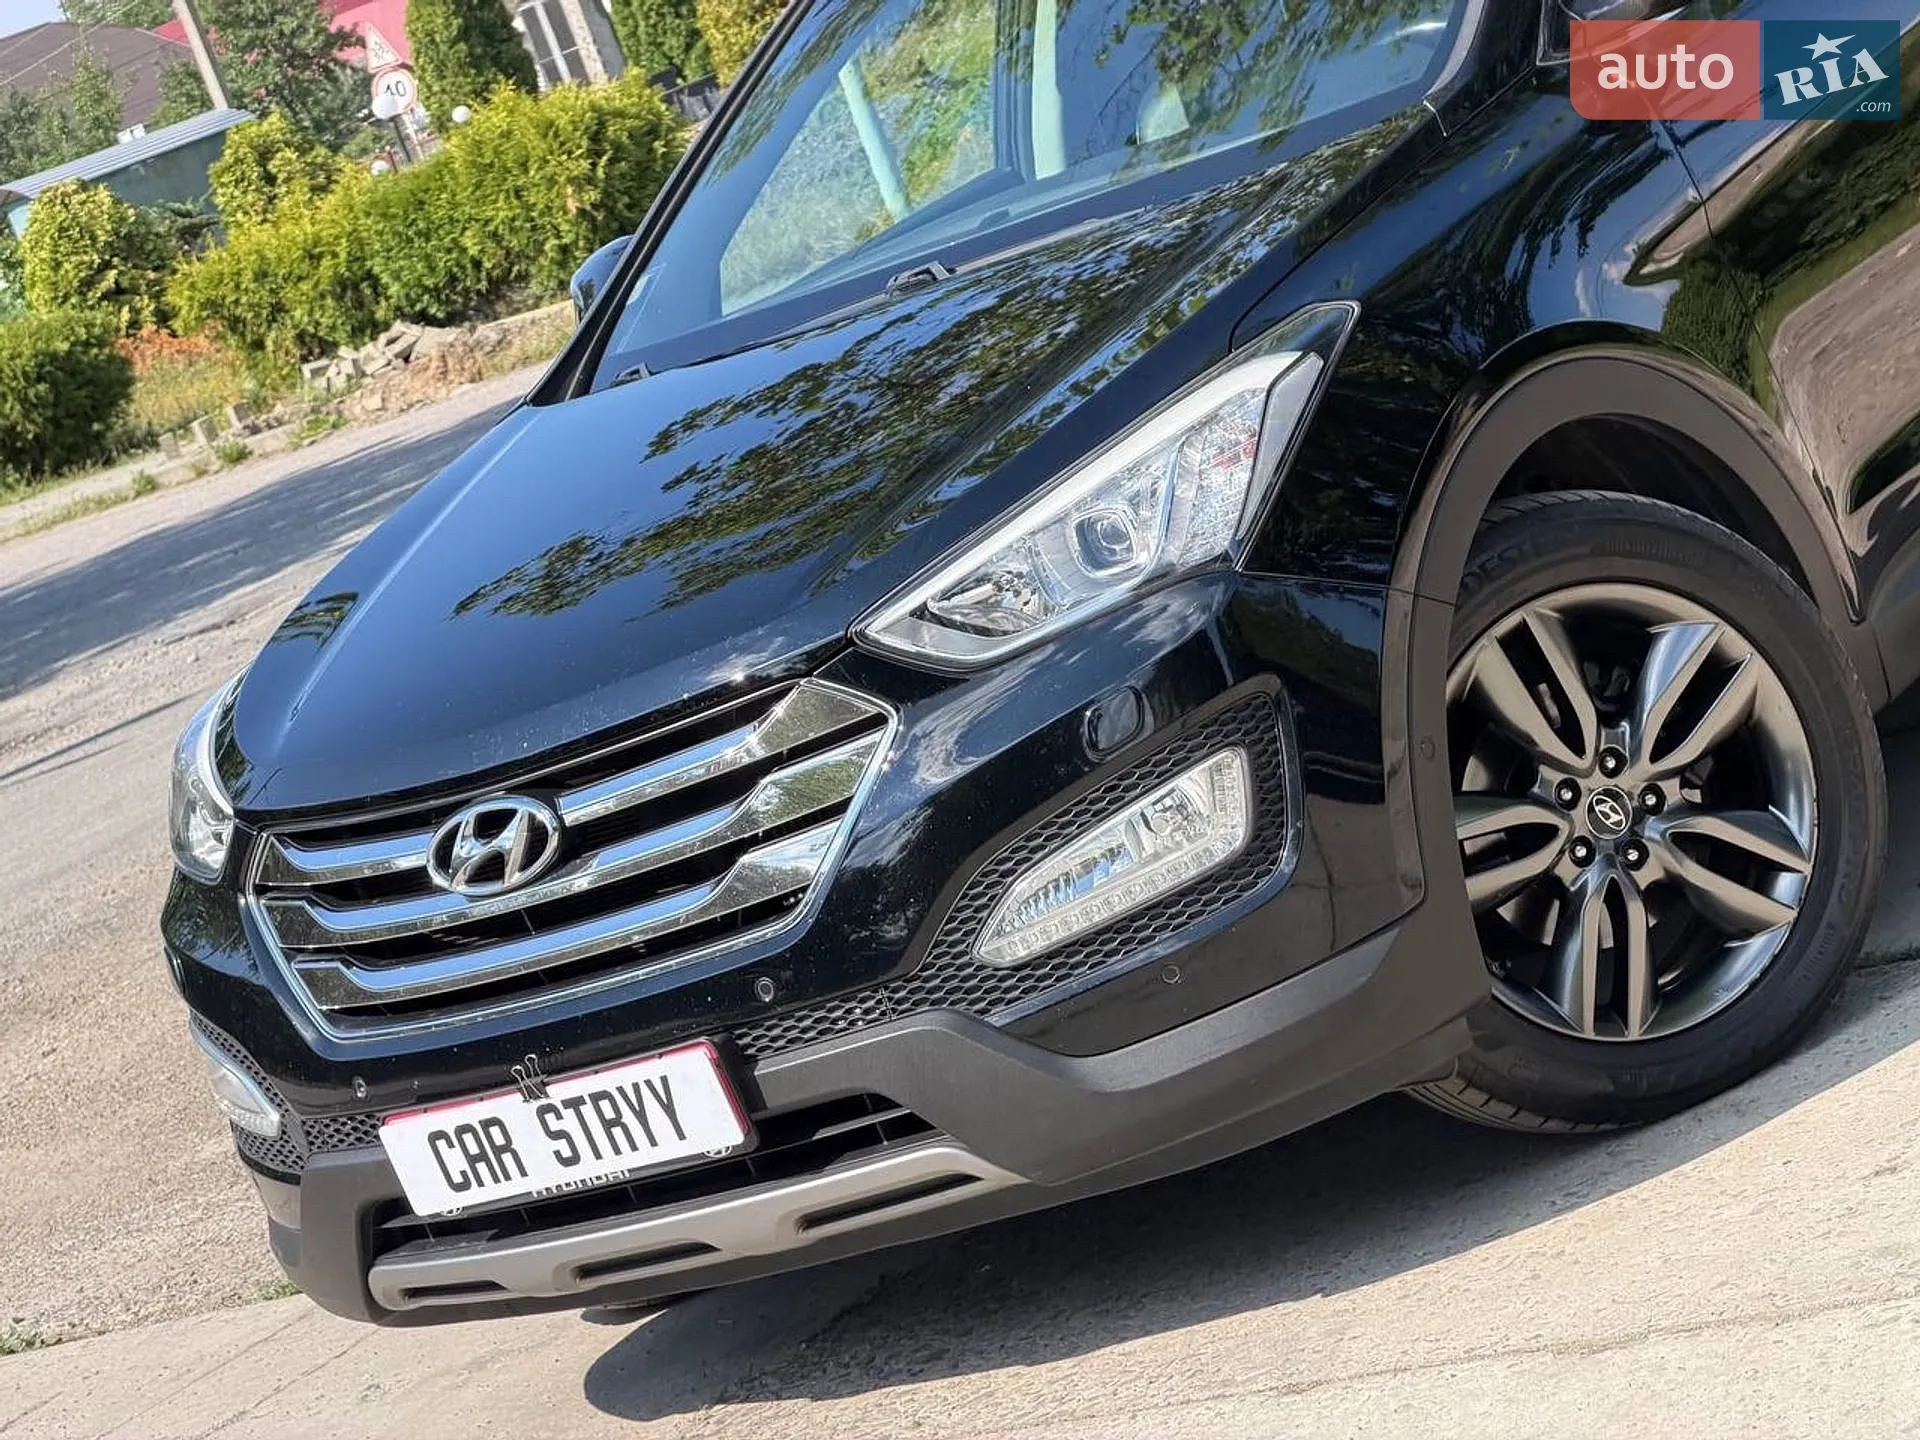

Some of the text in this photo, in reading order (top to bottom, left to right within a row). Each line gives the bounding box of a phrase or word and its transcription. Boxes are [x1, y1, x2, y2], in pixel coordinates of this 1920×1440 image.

[383, 81, 407, 97] 10
[428, 1075, 687, 1193] CAR STRYY
